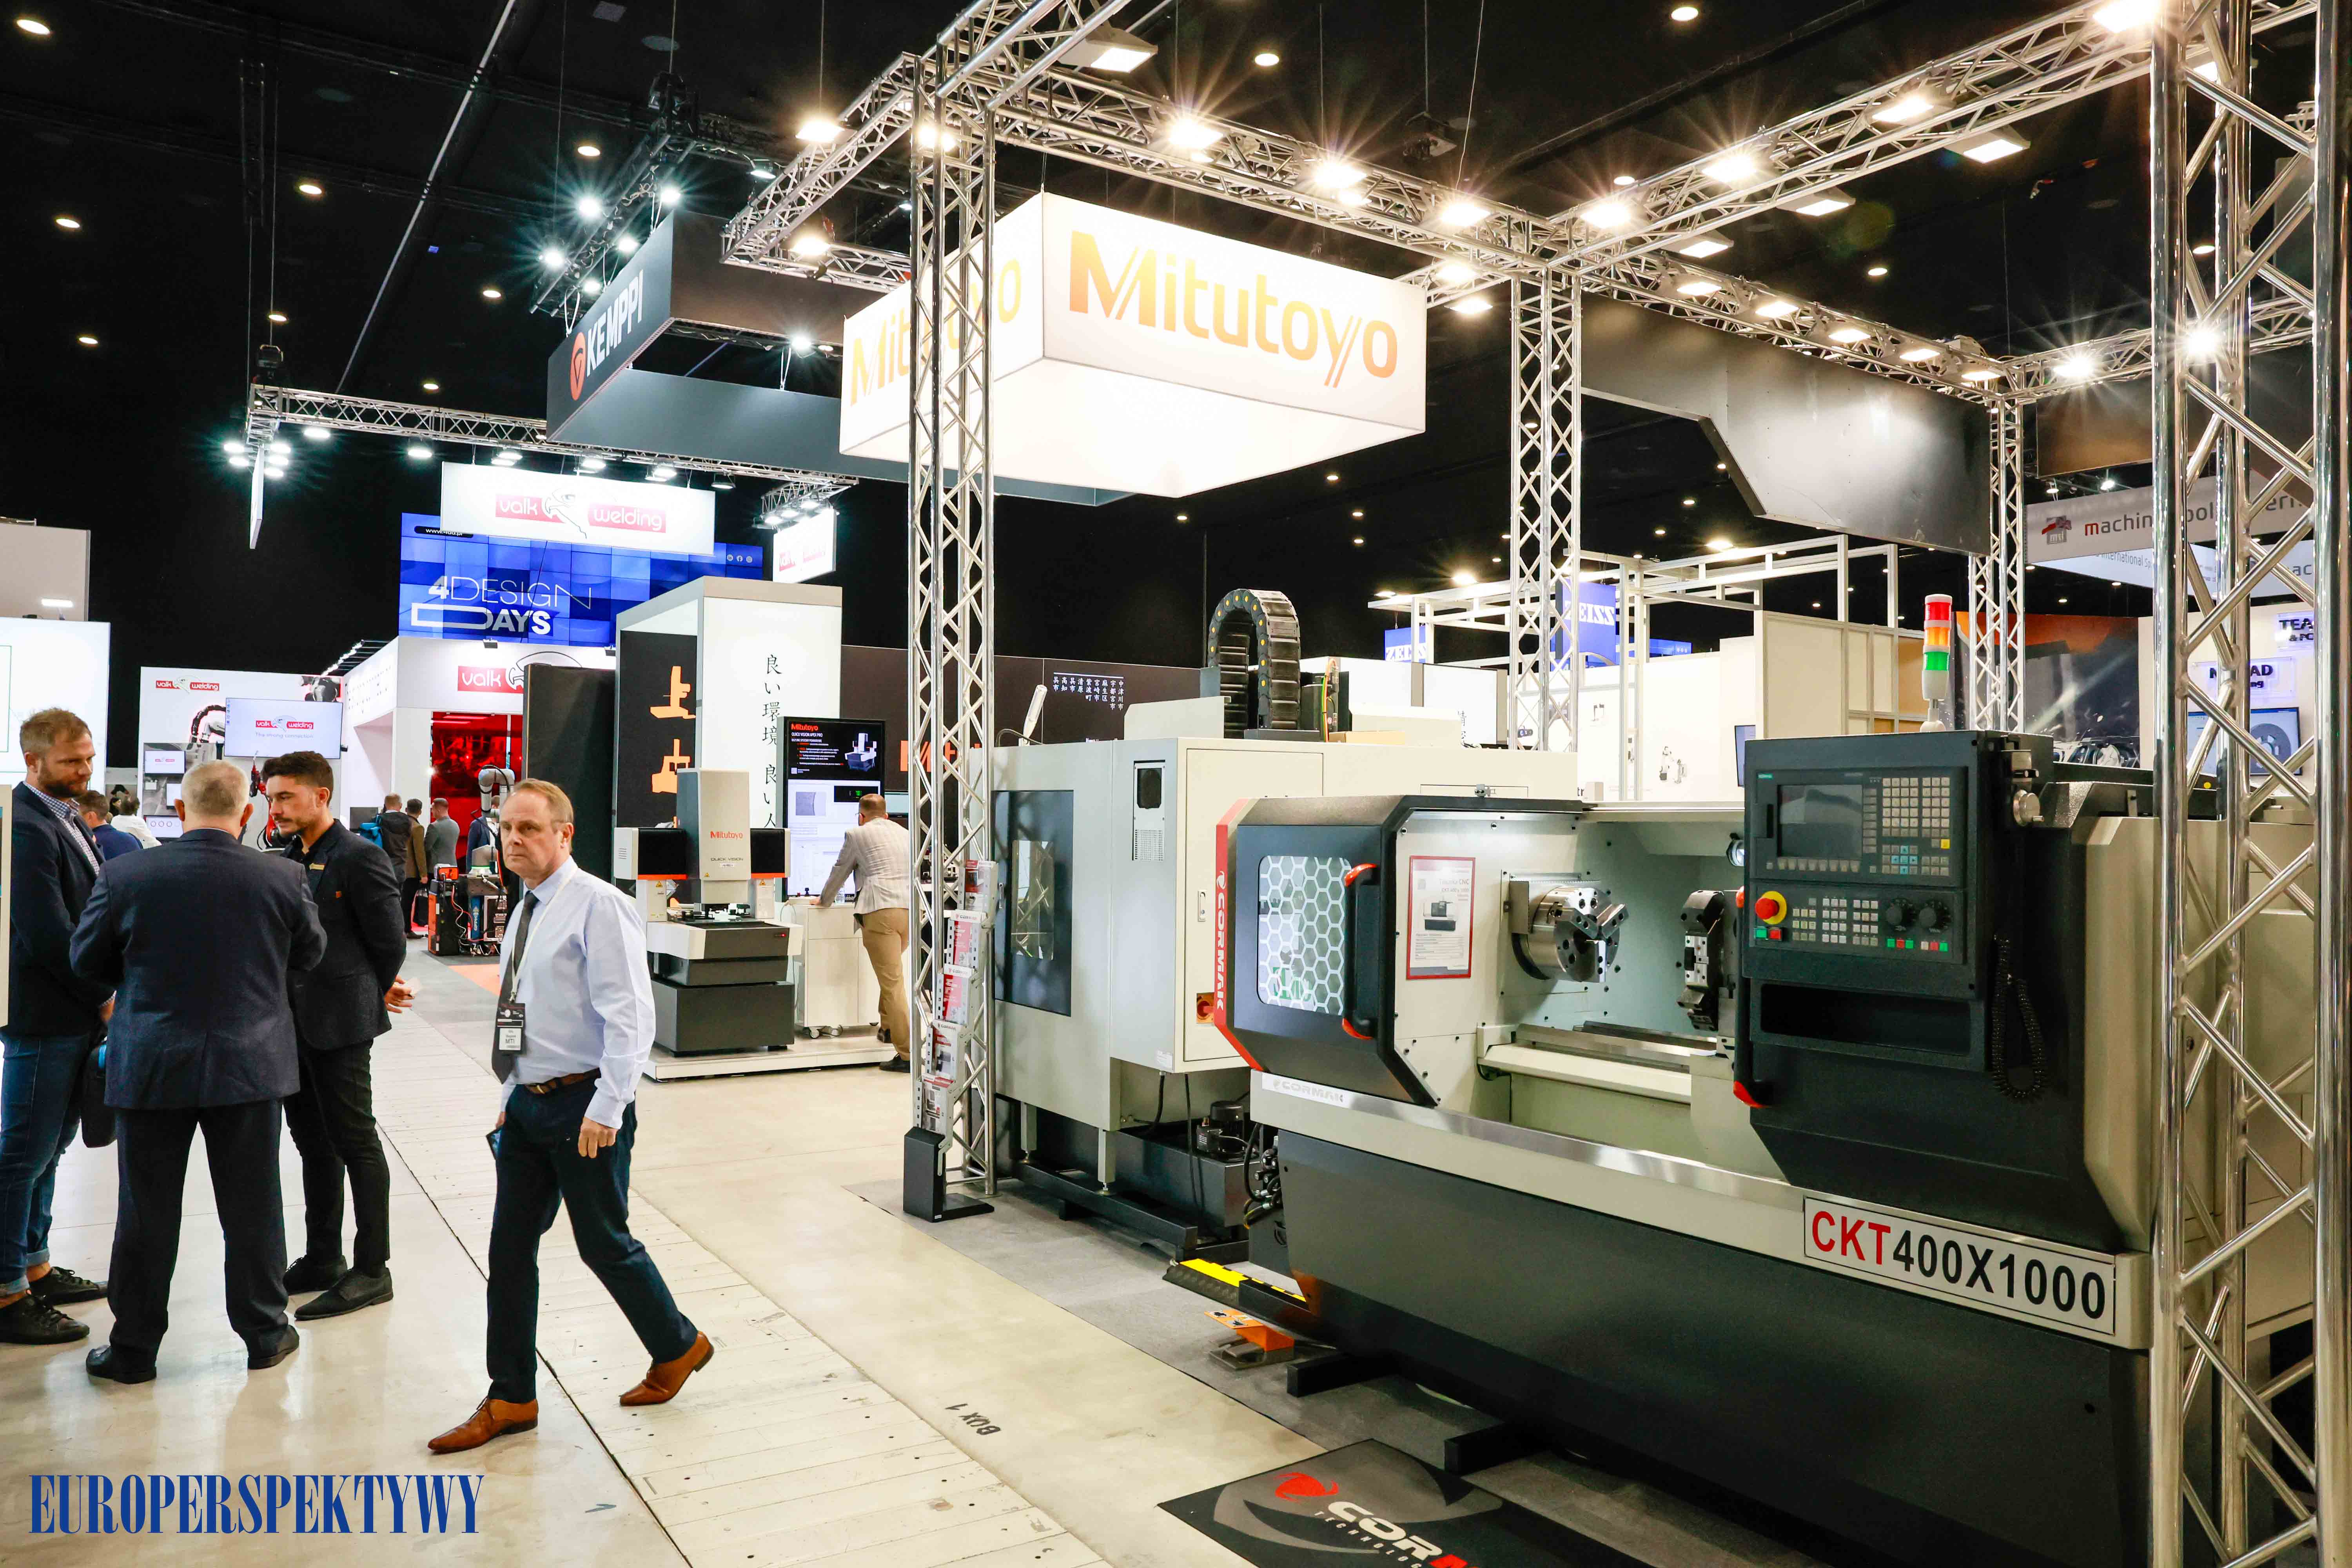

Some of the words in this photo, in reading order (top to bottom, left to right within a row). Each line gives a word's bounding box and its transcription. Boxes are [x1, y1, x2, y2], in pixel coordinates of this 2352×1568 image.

[1069, 230, 1397, 388] Mitutoyo
[585, 269, 644, 376] KEMPPI
[500, 497, 538, 517] valk
[593, 507, 663, 532] welding
[2085, 512, 2152, 536] machin
[411, 603, 551, 635] DAYS
[2279, 618, 2314, 630] TEA
[461, 669, 501, 687] valk
[2250, 664, 2274, 676] AD
[791, 723, 818, 732] Mitutoyo
[710, 831, 743, 840] Mitutoyo
[1280, 1079, 1343, 1103] CORMAK
[1812, 1210, 2105, 1319] CKT400X1000
[1314, 1511, 1422, 1568] TECHNOLOG
